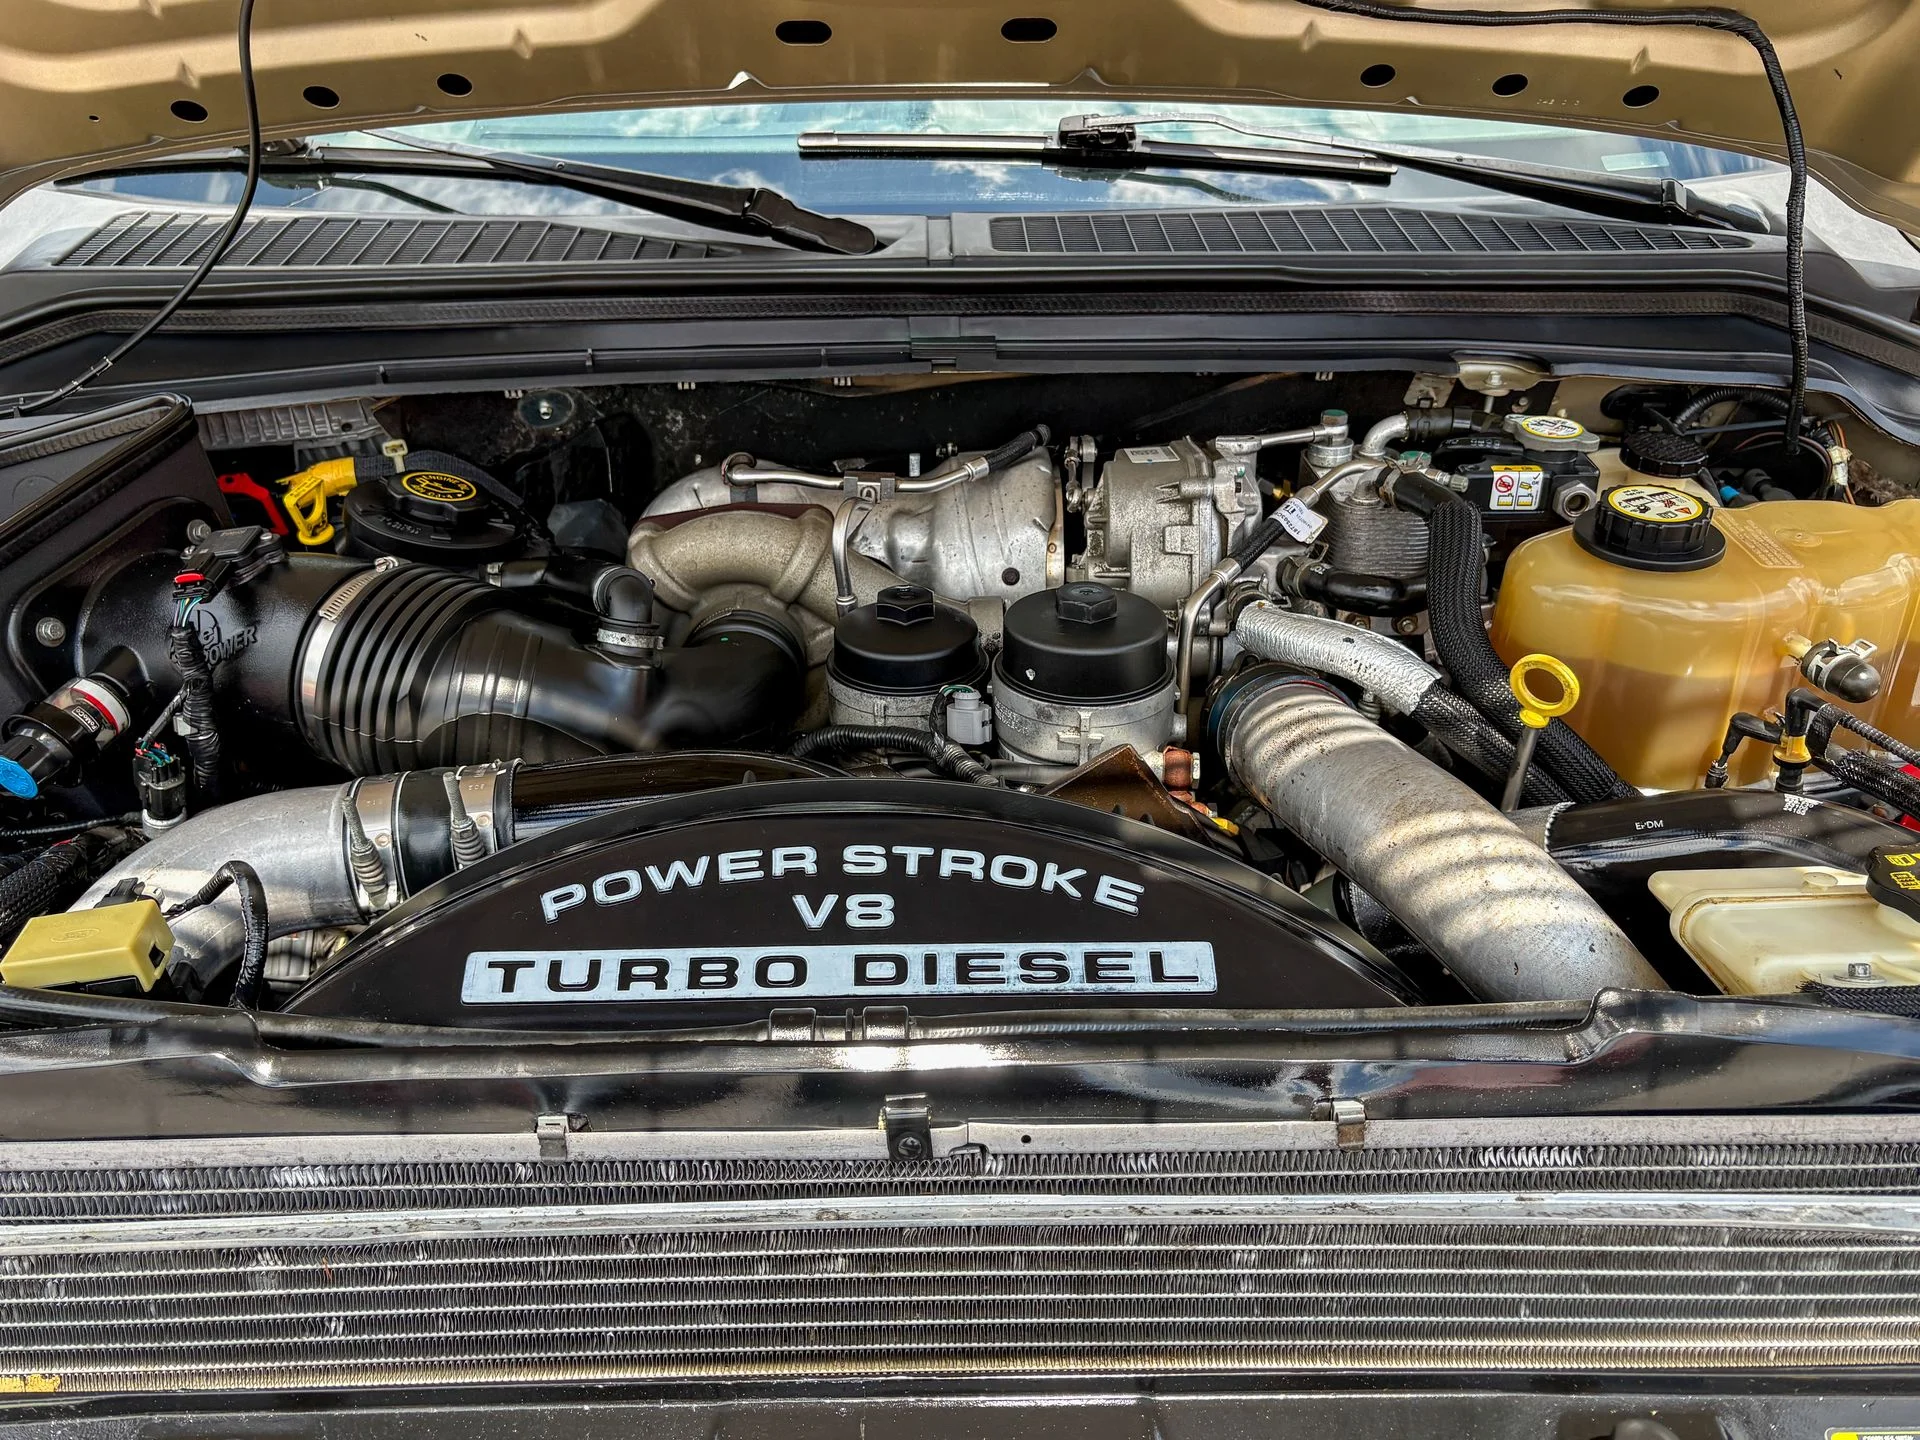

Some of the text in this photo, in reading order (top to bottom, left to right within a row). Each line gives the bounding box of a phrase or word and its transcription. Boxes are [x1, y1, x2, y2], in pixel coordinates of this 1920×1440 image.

[540, 844, 1145, 924] POWER STROKE
[792, 893, 896, 931] V8
[487, 951, 1200, 993] TURBO DIESEL
